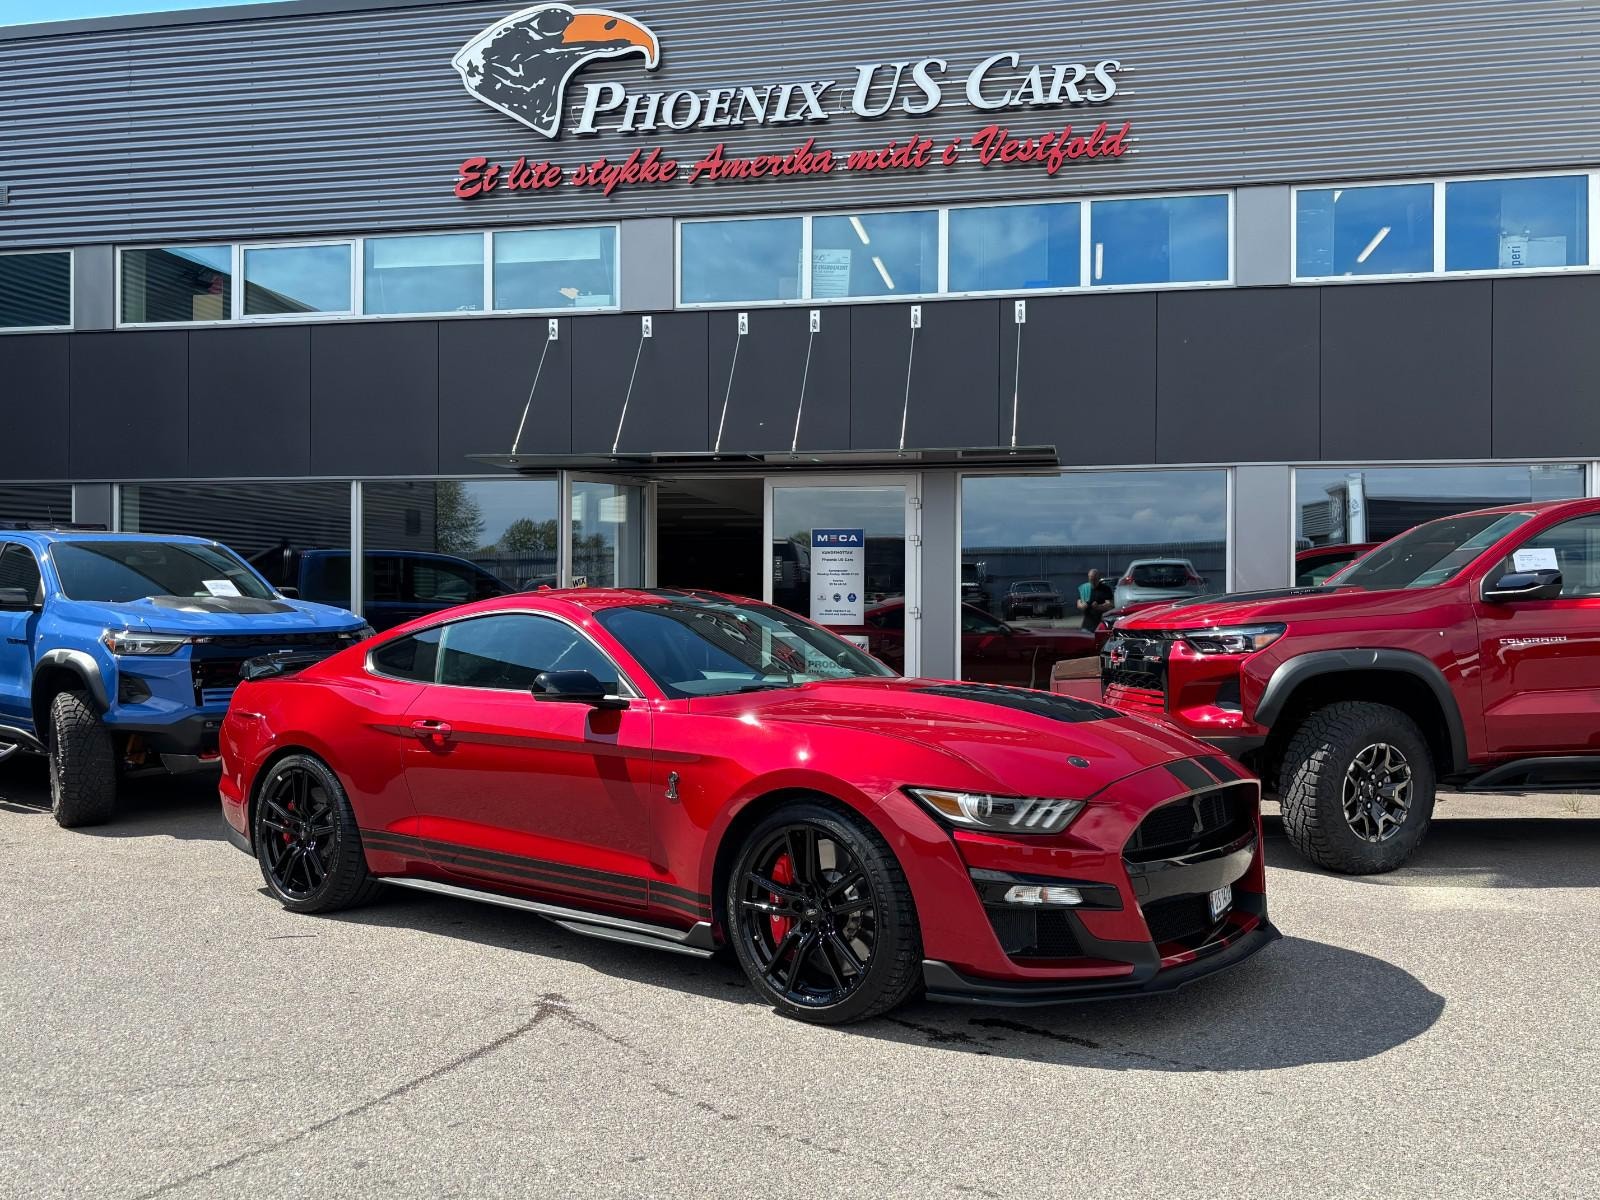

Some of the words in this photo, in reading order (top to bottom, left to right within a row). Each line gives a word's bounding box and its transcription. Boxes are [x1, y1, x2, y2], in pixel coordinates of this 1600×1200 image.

[572, 80, 836, 134] PHOENIX
[851, 58, 947, 117] US
[965, 52, 1121, 110] CARS
[454, 156, 499, 198] Et
[507, 154, 562, 190] lite
[571, 146, 678, 196] stykke
[688, 137, 835, 183] Amerika
[847, 133, 933, 170] midt
[942, 137, 961, 165] i
[971, 121, 1131, 175] Vestfold
[817, 534, 858, 543] MECA
[1499, 636, 1567, 644] COLORADO
